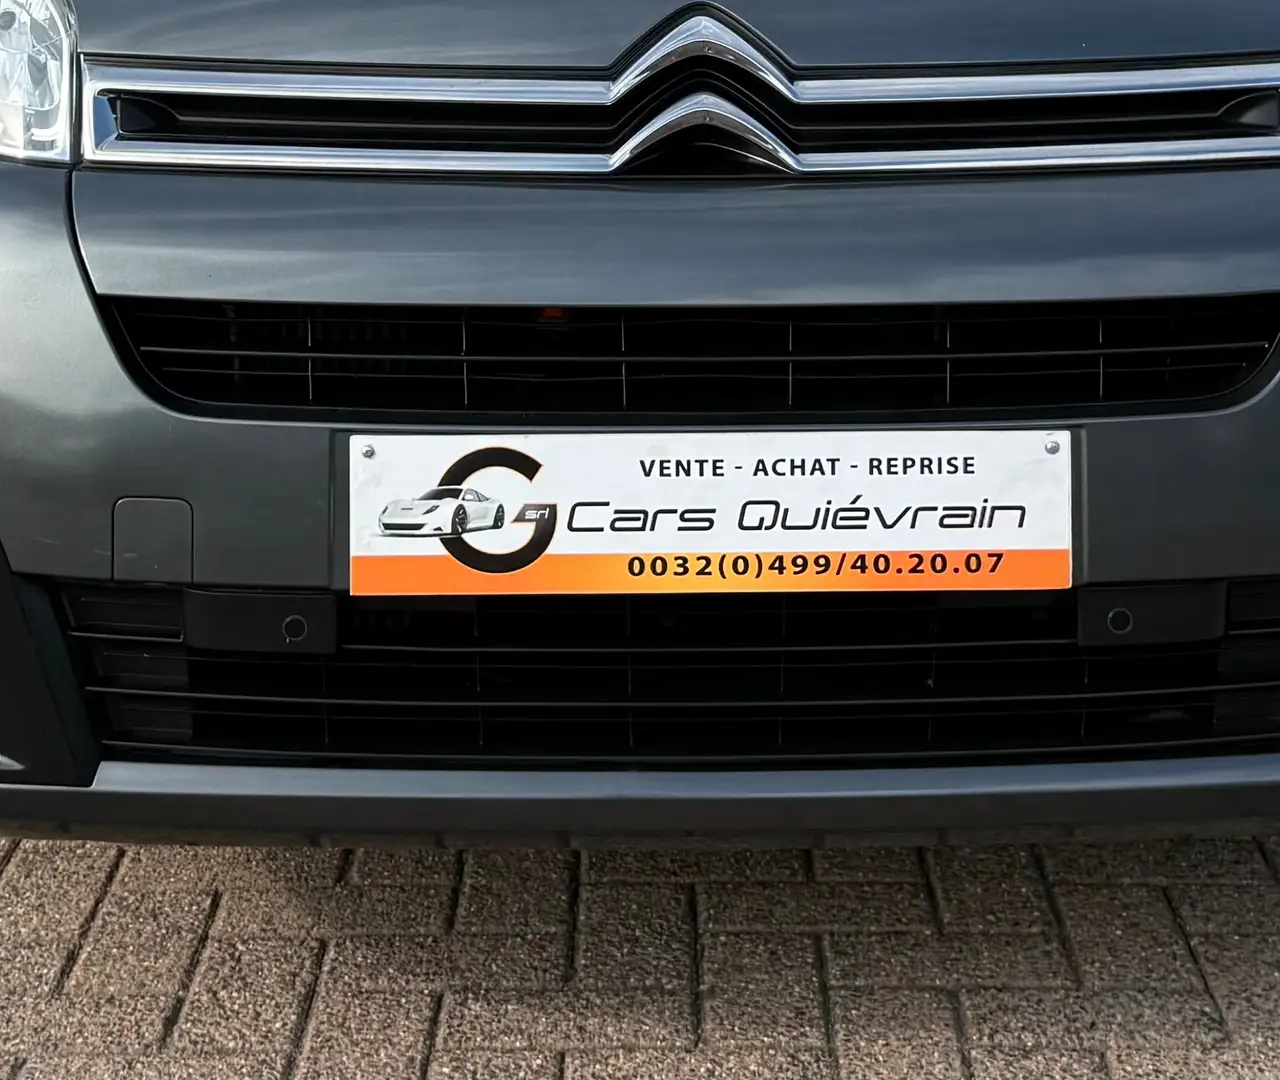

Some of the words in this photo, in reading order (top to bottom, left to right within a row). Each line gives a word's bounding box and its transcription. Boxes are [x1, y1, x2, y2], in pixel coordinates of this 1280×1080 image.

[639, 458, 725, 478] VENTE
[752, 457, 841, 477] ACHAT
[868, 456, 976, 476] REPRISE
[566, 501, 717, 533] Cars
[737, 493, 1027, 532] Quiévrain
[627, 552, 1005, 580] 0032(0)499/40.20.07
